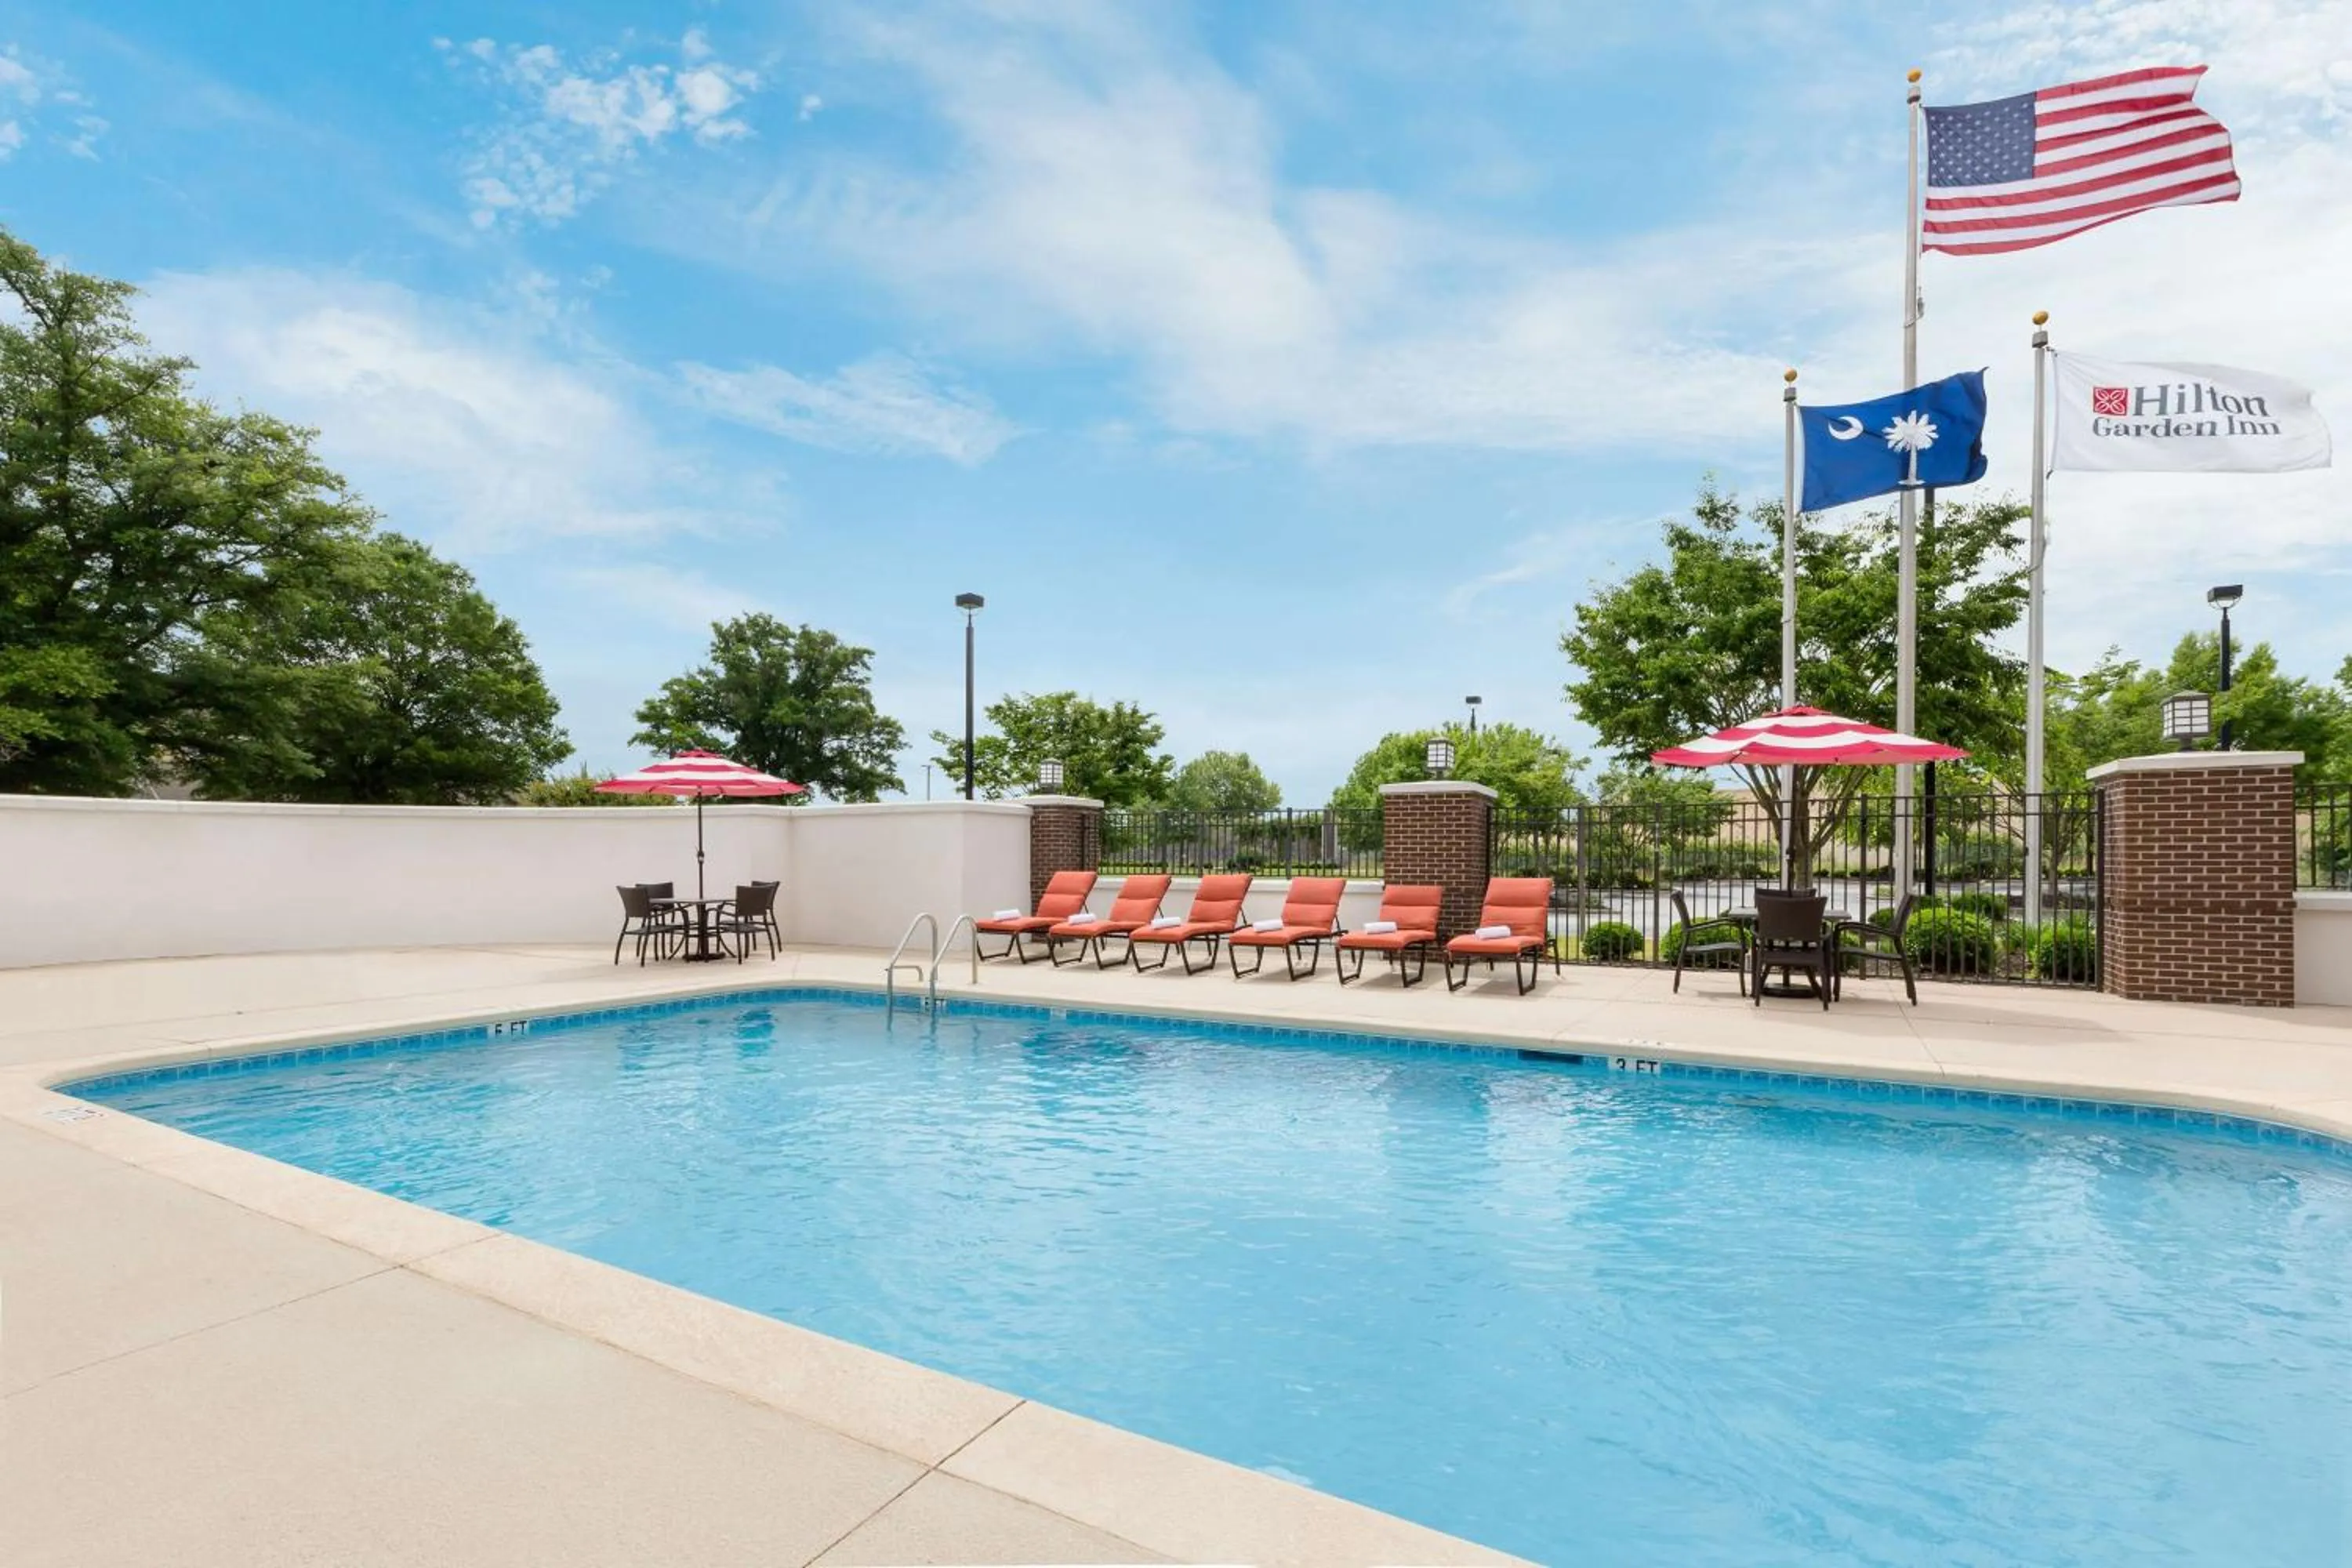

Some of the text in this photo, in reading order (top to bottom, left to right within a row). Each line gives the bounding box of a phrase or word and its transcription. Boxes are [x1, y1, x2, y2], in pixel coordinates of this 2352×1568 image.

[2132, 383, 2270, 417] Hilton
[2092, 415, 2281, 437] Garden Inn
[1636, 1059, 1658, 1073] FT
